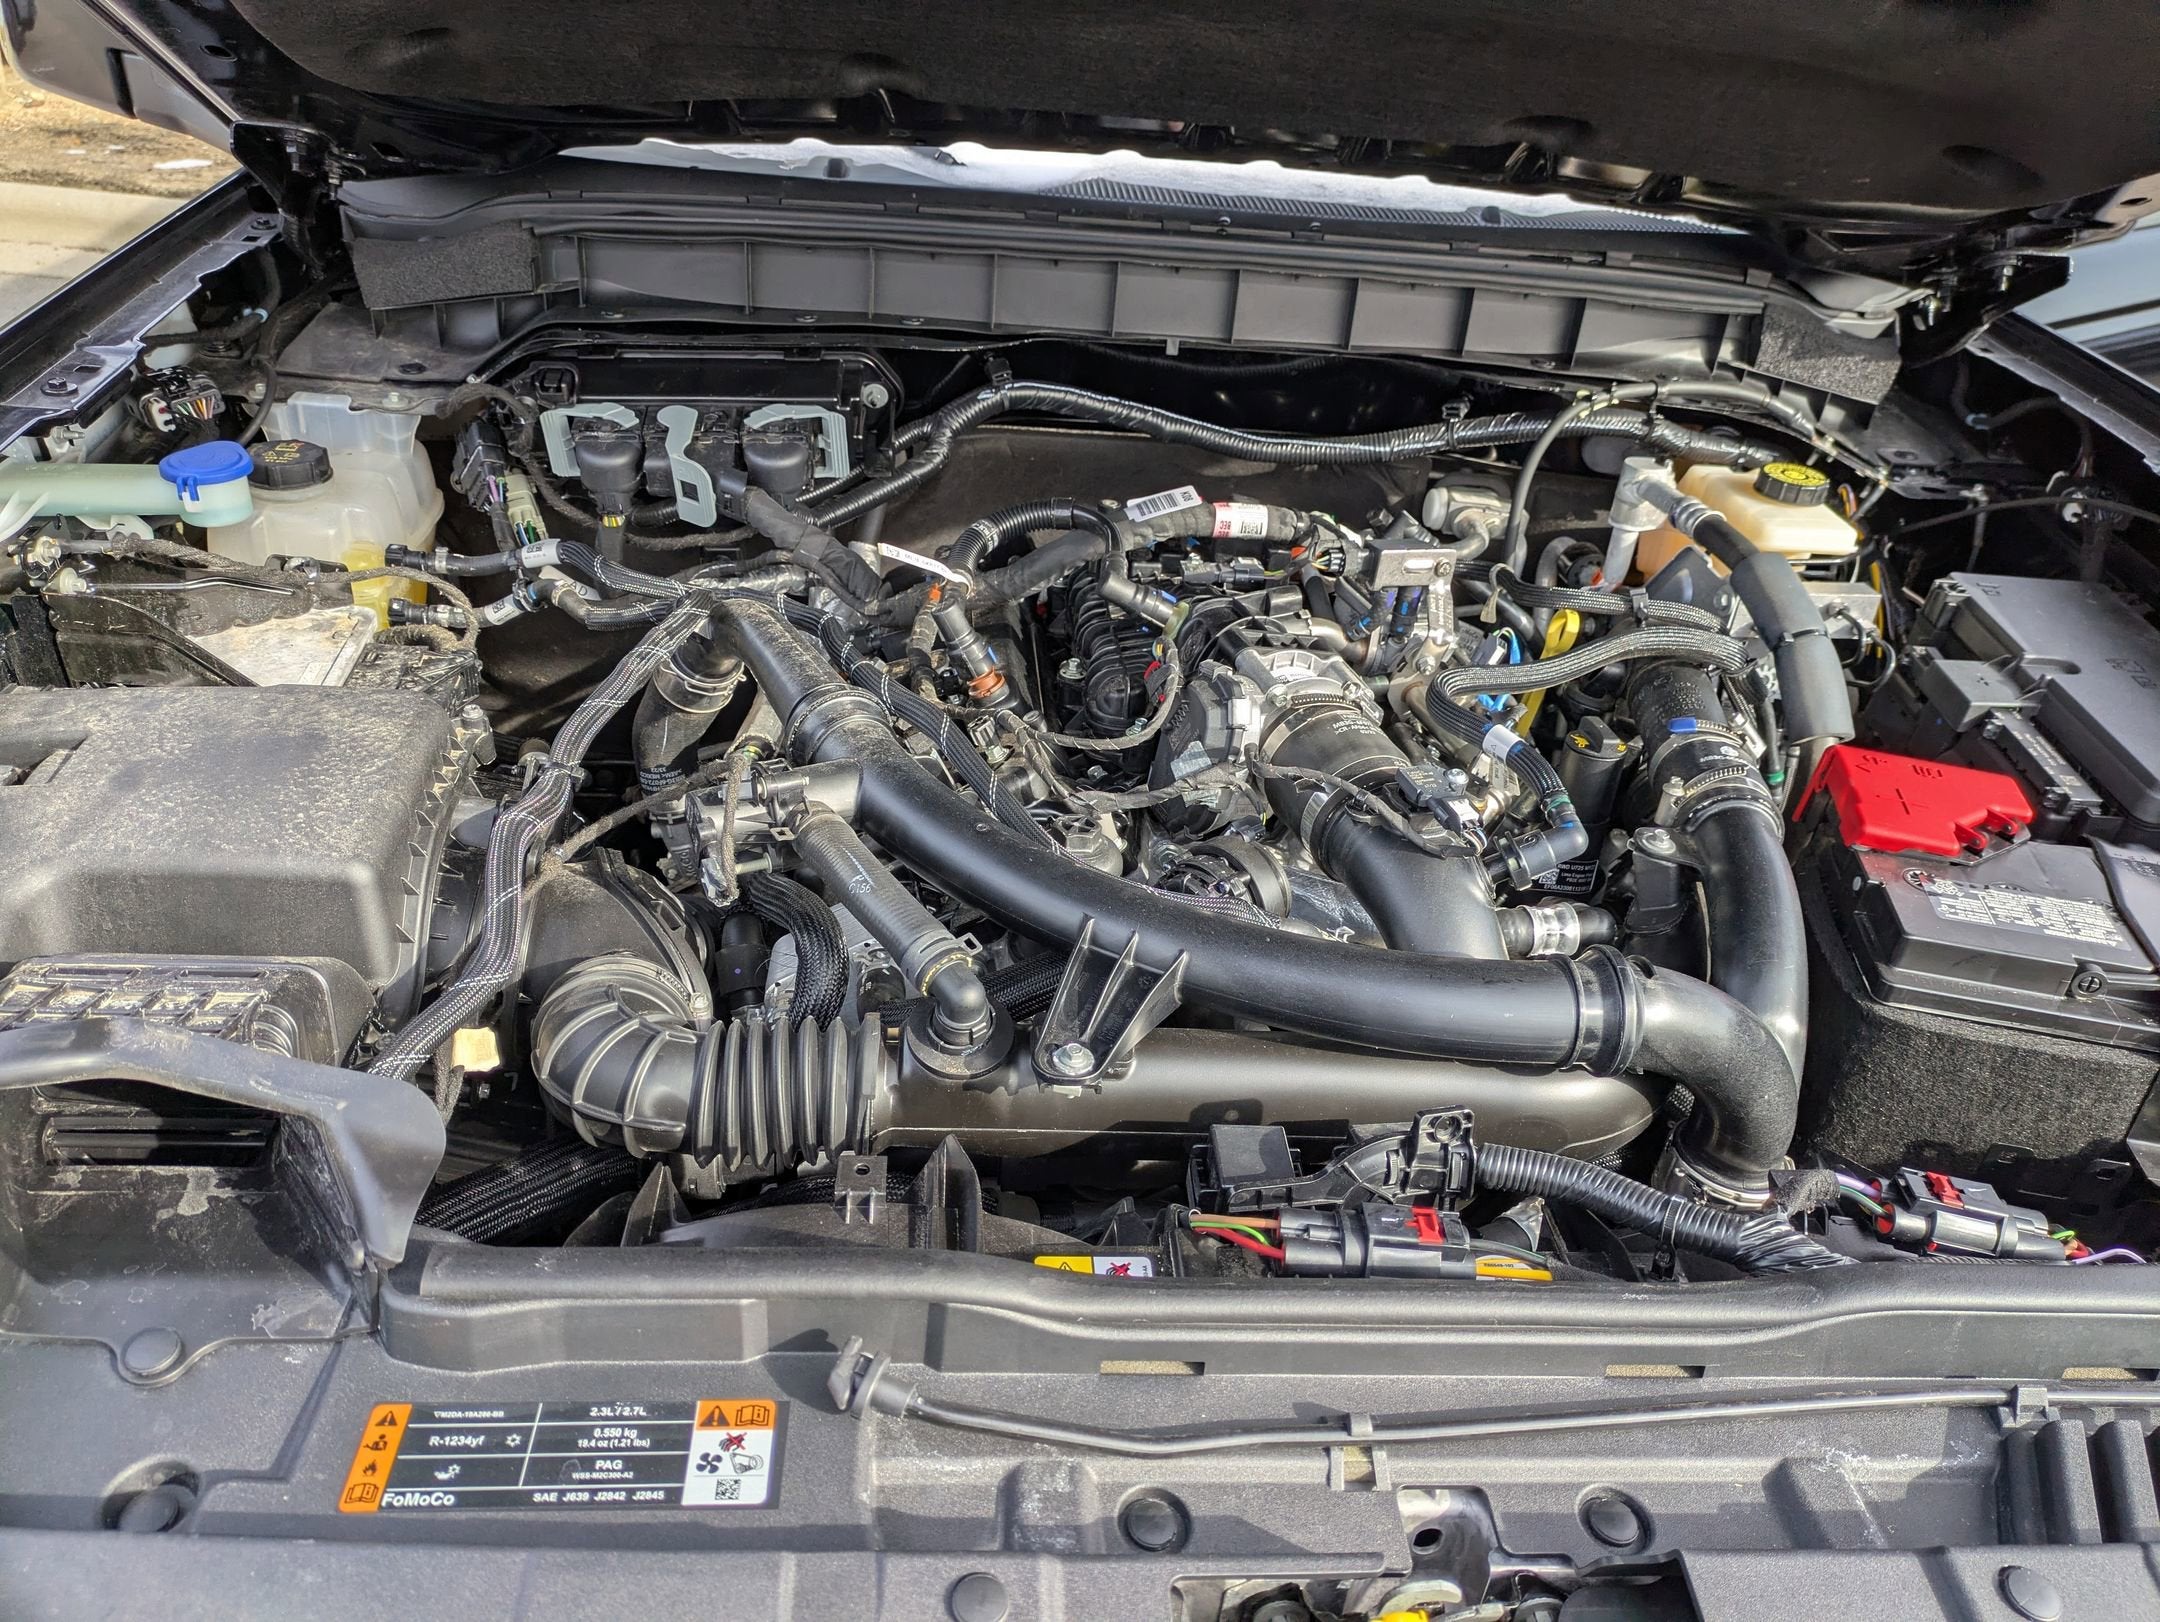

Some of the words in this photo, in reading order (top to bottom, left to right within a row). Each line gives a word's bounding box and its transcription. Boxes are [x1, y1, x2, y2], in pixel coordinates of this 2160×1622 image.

[589, 1406, 614, 1417] 2.3L
[622, 1406, 647, 1417] 2.7L
[593, 1428, 622, 1438] 0.550
[623, 1427, 638, 1439] kg
[429, 1435, 486, 1448] R-1234yf
[597, 1440, 609, 1448] oz
[610, 1438, 632, 1449] (1.21
[632, 1438, 650, 1449] lbs)
[595, 1460, 623, 1470] PAG
[381, 1492, 456, 1507] FoMoCo
[532, 1492, 559, 1502] SAE
[562, 1492, 590, 1502] J639
[593, 1491, 626, 1502] J2842
[632, 1490, 665, 1501] J2845
